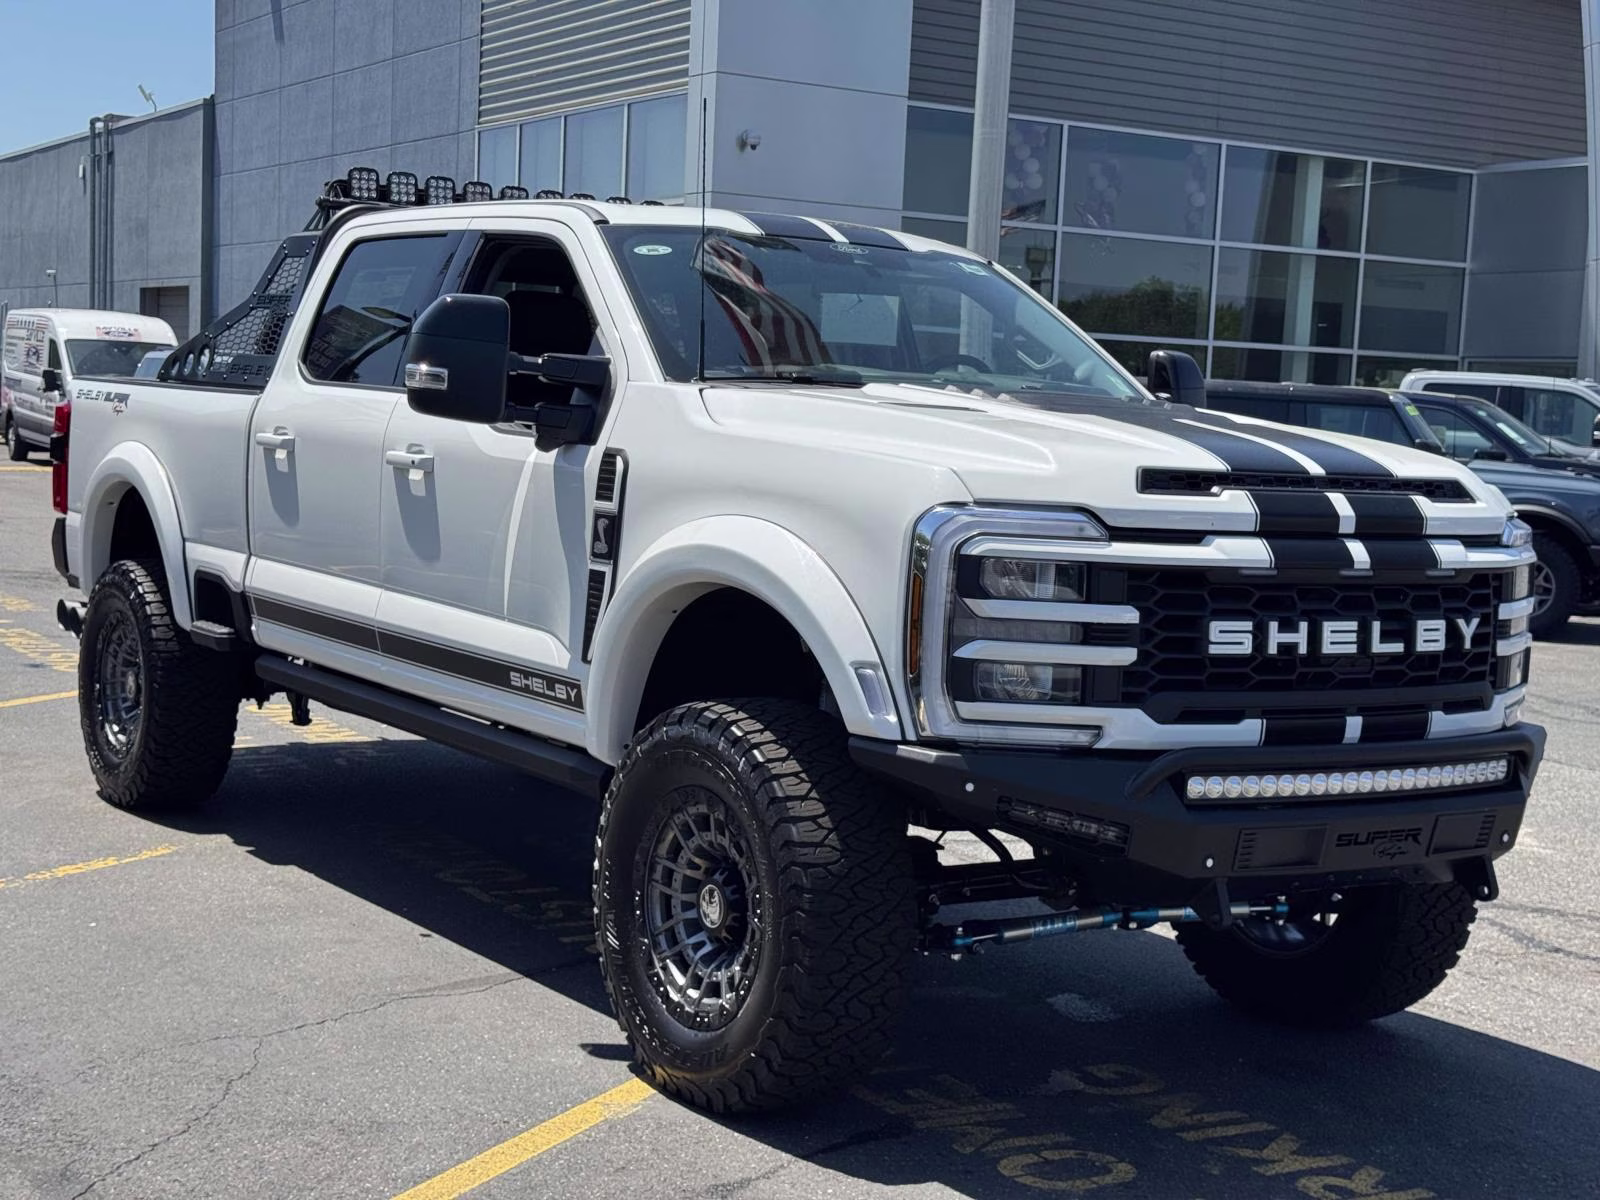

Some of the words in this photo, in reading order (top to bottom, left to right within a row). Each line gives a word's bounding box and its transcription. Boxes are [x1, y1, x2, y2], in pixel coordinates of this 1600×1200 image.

[1208, 617, 1480, 655] SHELBY
[509, 671, 578, 702] SHELBY
[1335, 828, 1422, 848] SUPER
